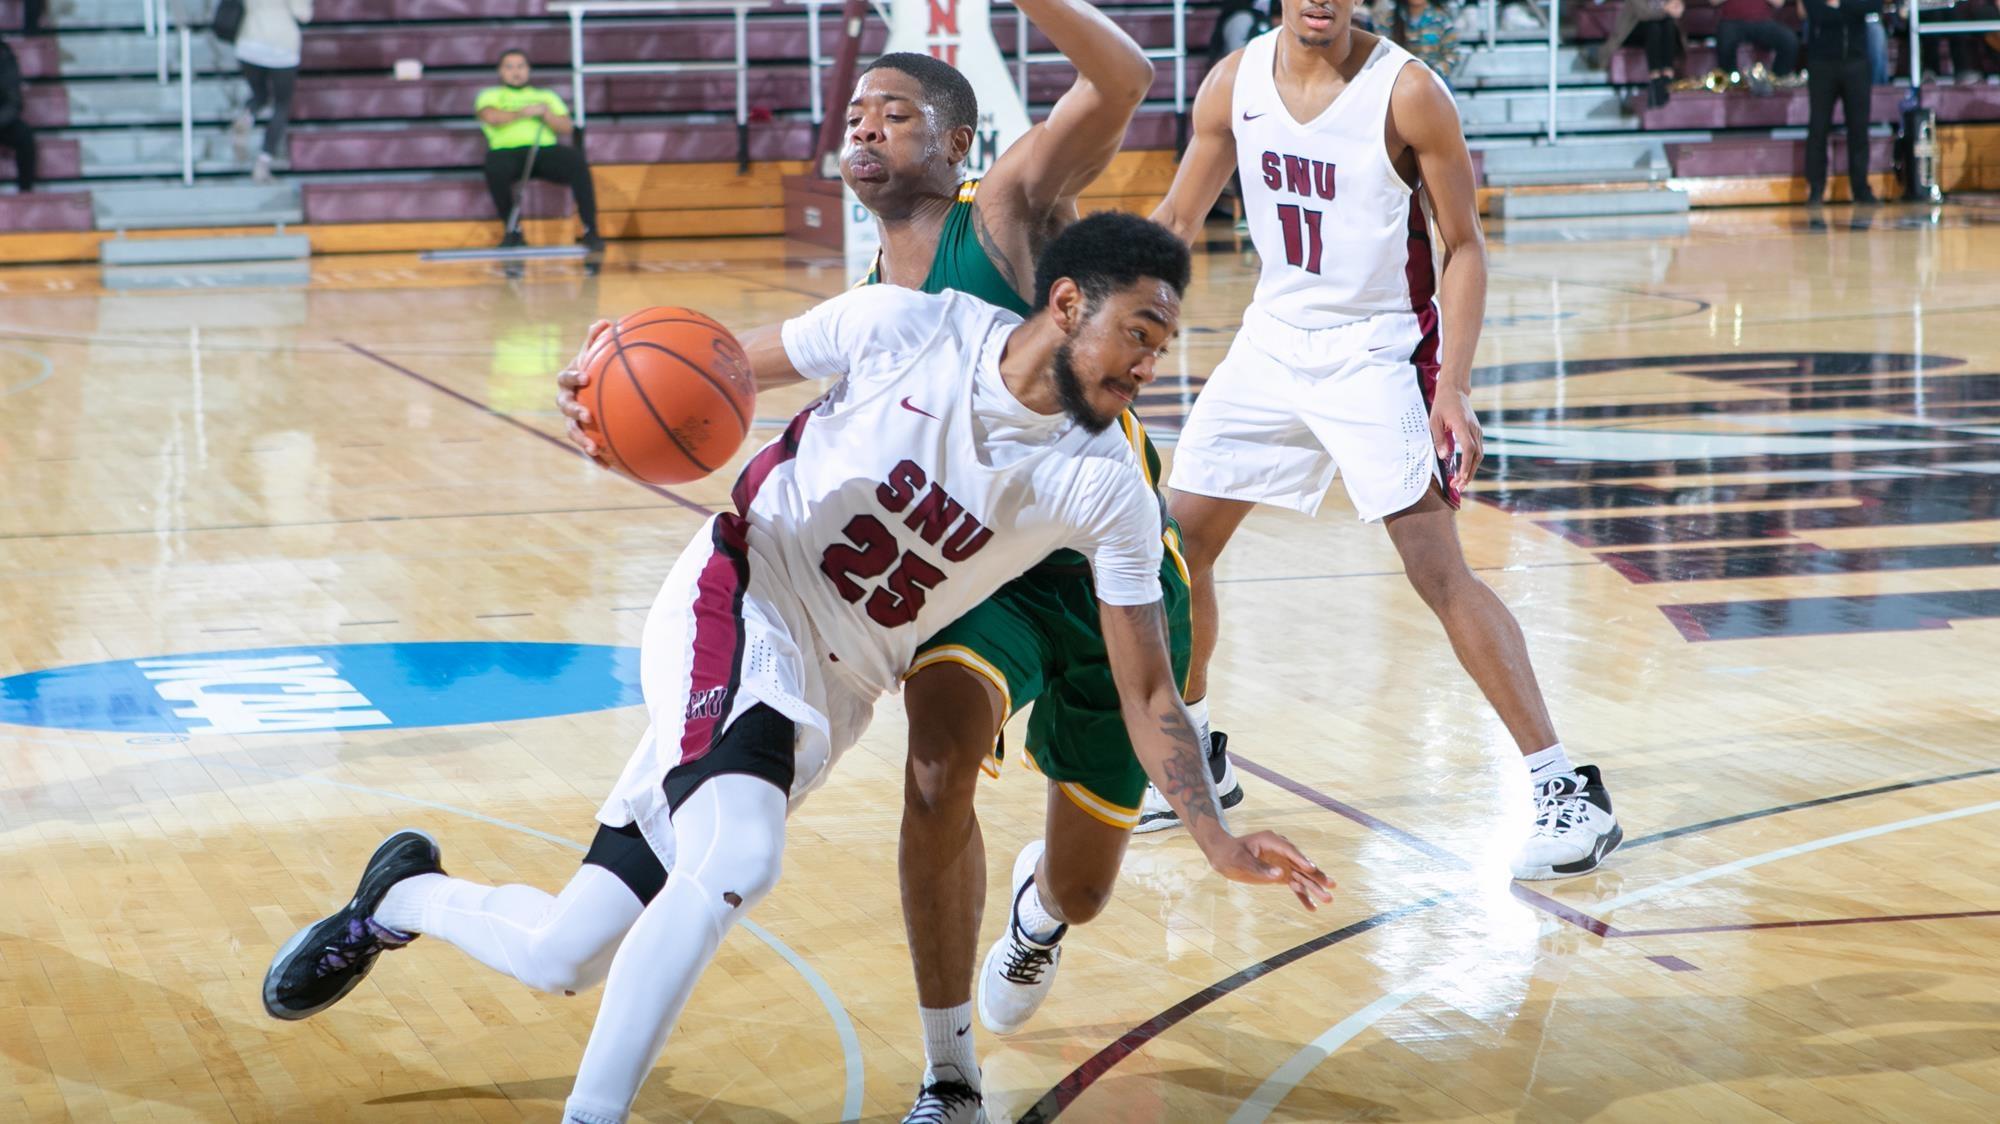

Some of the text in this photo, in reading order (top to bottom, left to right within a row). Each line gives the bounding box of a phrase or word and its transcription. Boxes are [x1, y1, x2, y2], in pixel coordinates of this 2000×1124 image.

[1261, 150, 1336, 201] SNU
[1276, 203, 1323, 276] 11
[875, 459, 994, 563] SNU
[819, 514, 948, 628] 25
[134, 655, 393, 735] NCAA
